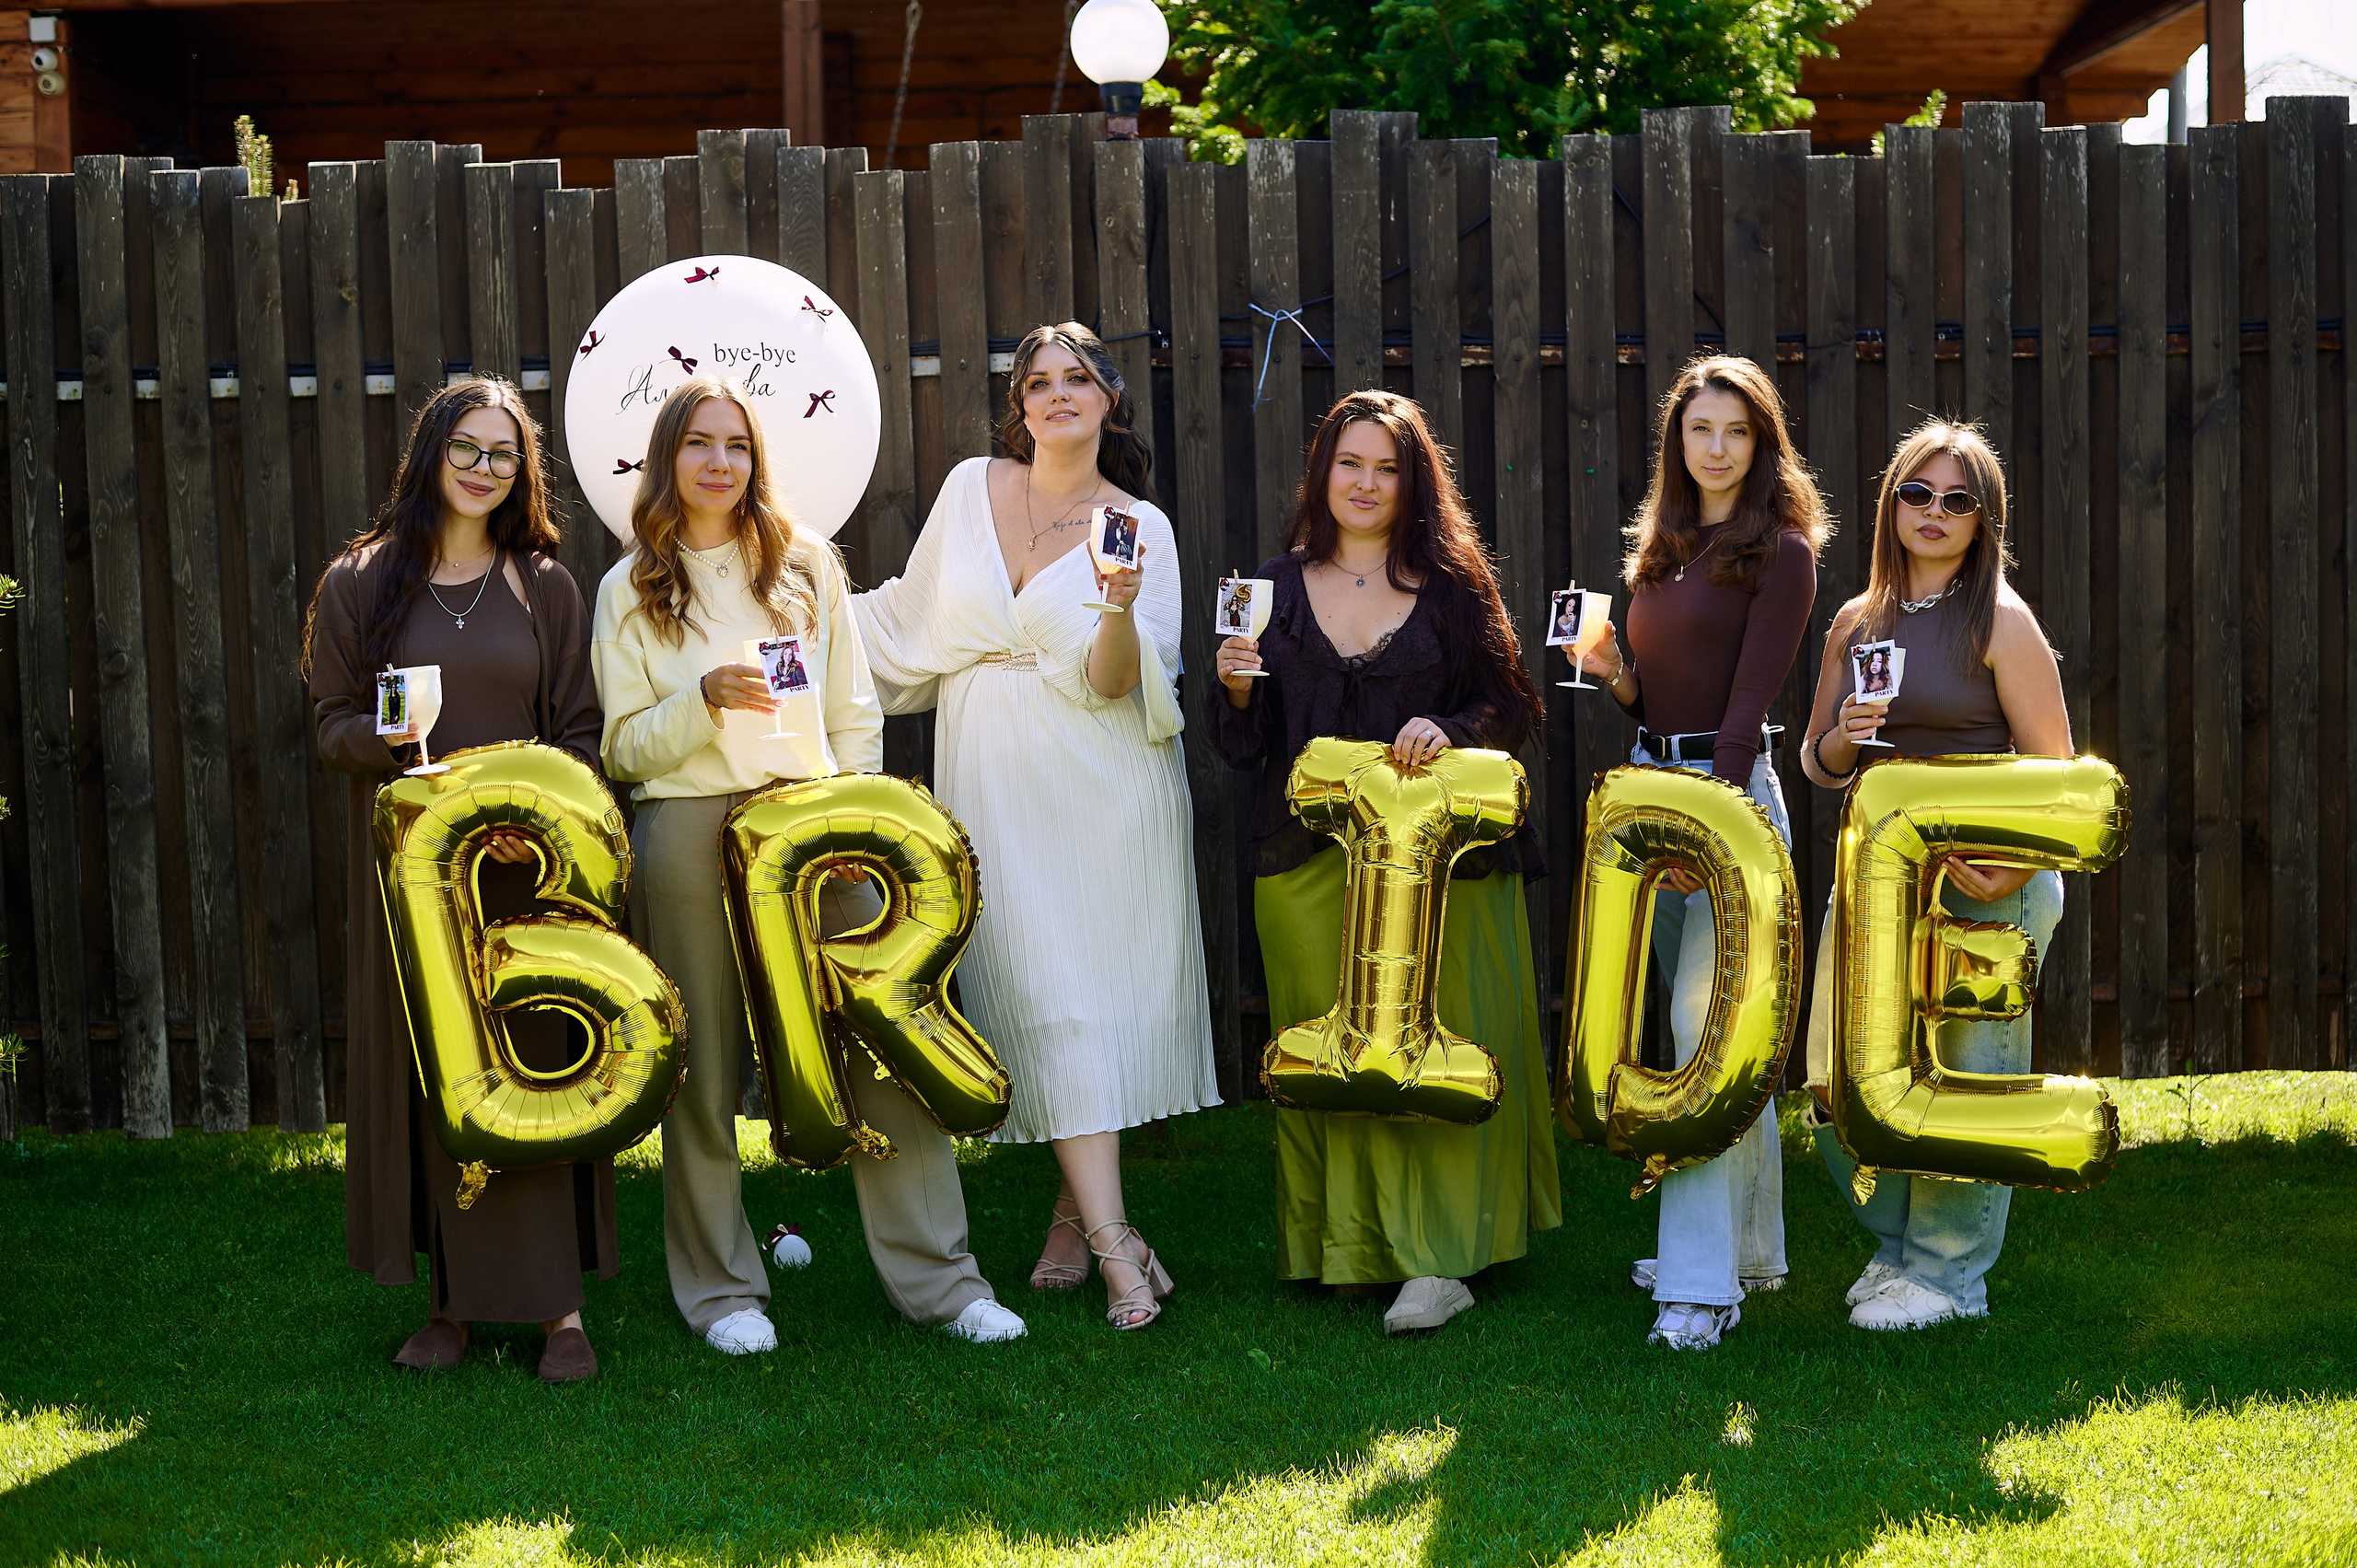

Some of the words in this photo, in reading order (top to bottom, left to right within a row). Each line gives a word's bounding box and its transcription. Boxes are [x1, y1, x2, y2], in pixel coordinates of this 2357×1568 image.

[714, 342, 796, 367] bye-bye
[1115, 556, 1132, 566] PARTY
[789, 684, 809, 692] PARTY
[1875, 689, 1894, 697] PARTY
[371, 737, 2132, 1195] BRIDE
